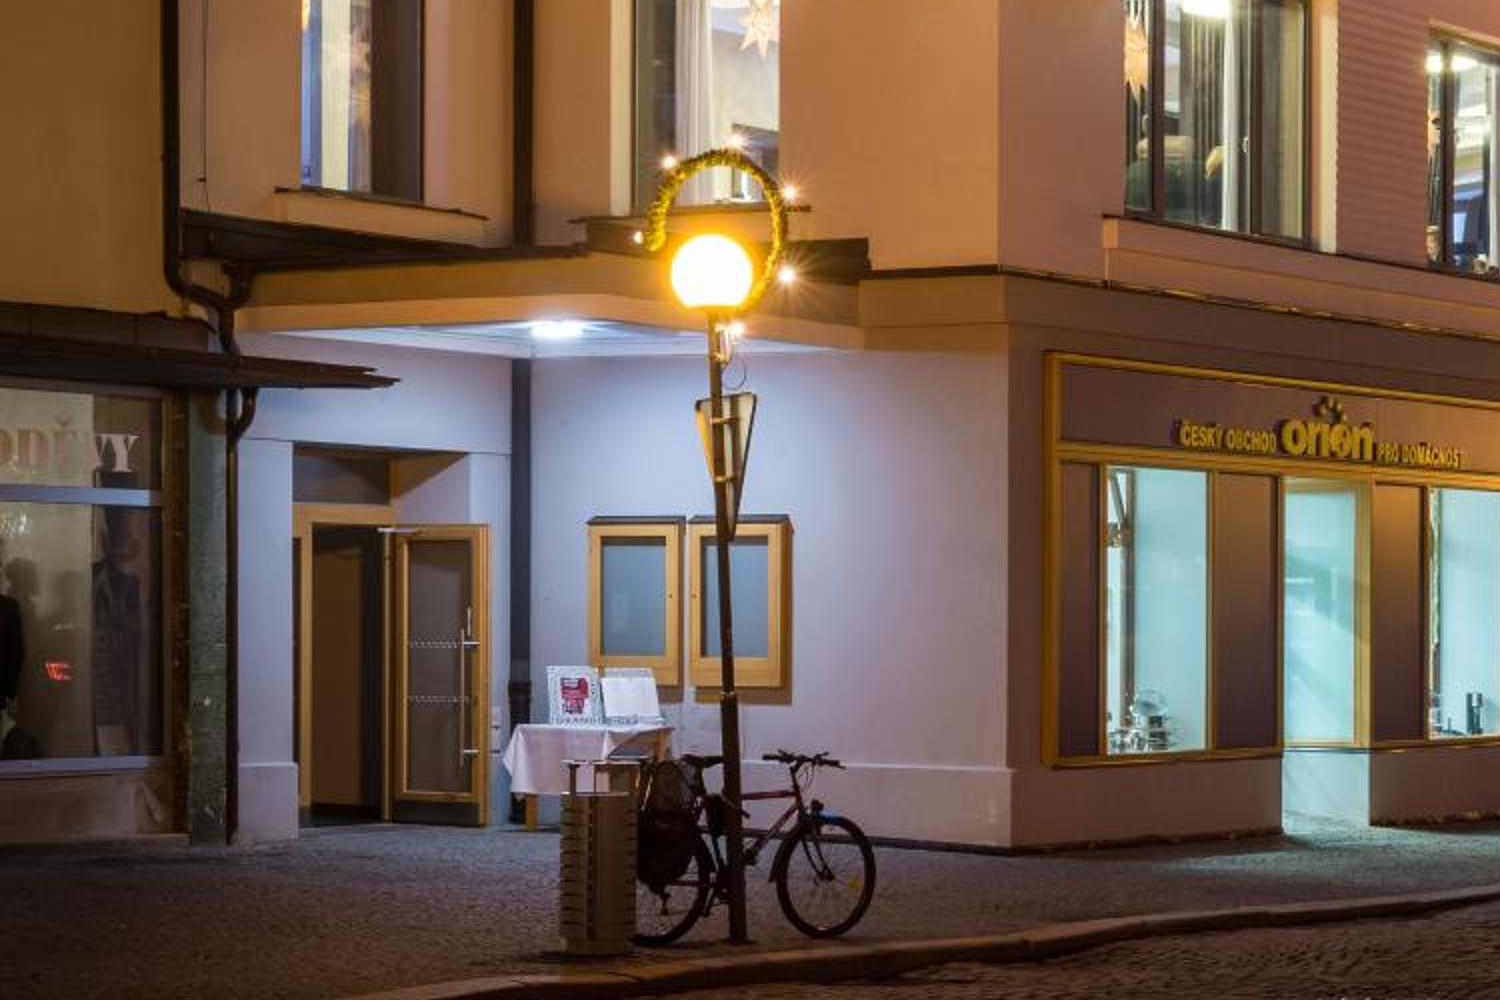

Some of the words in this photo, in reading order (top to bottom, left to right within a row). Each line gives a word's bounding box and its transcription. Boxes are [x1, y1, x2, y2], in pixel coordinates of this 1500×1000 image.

[1180, 419, 1223, 448] ČESKÝ
[1226, 427, 1278, 453] OBCHOD
[1377, 442, 1399, 464] PRO
